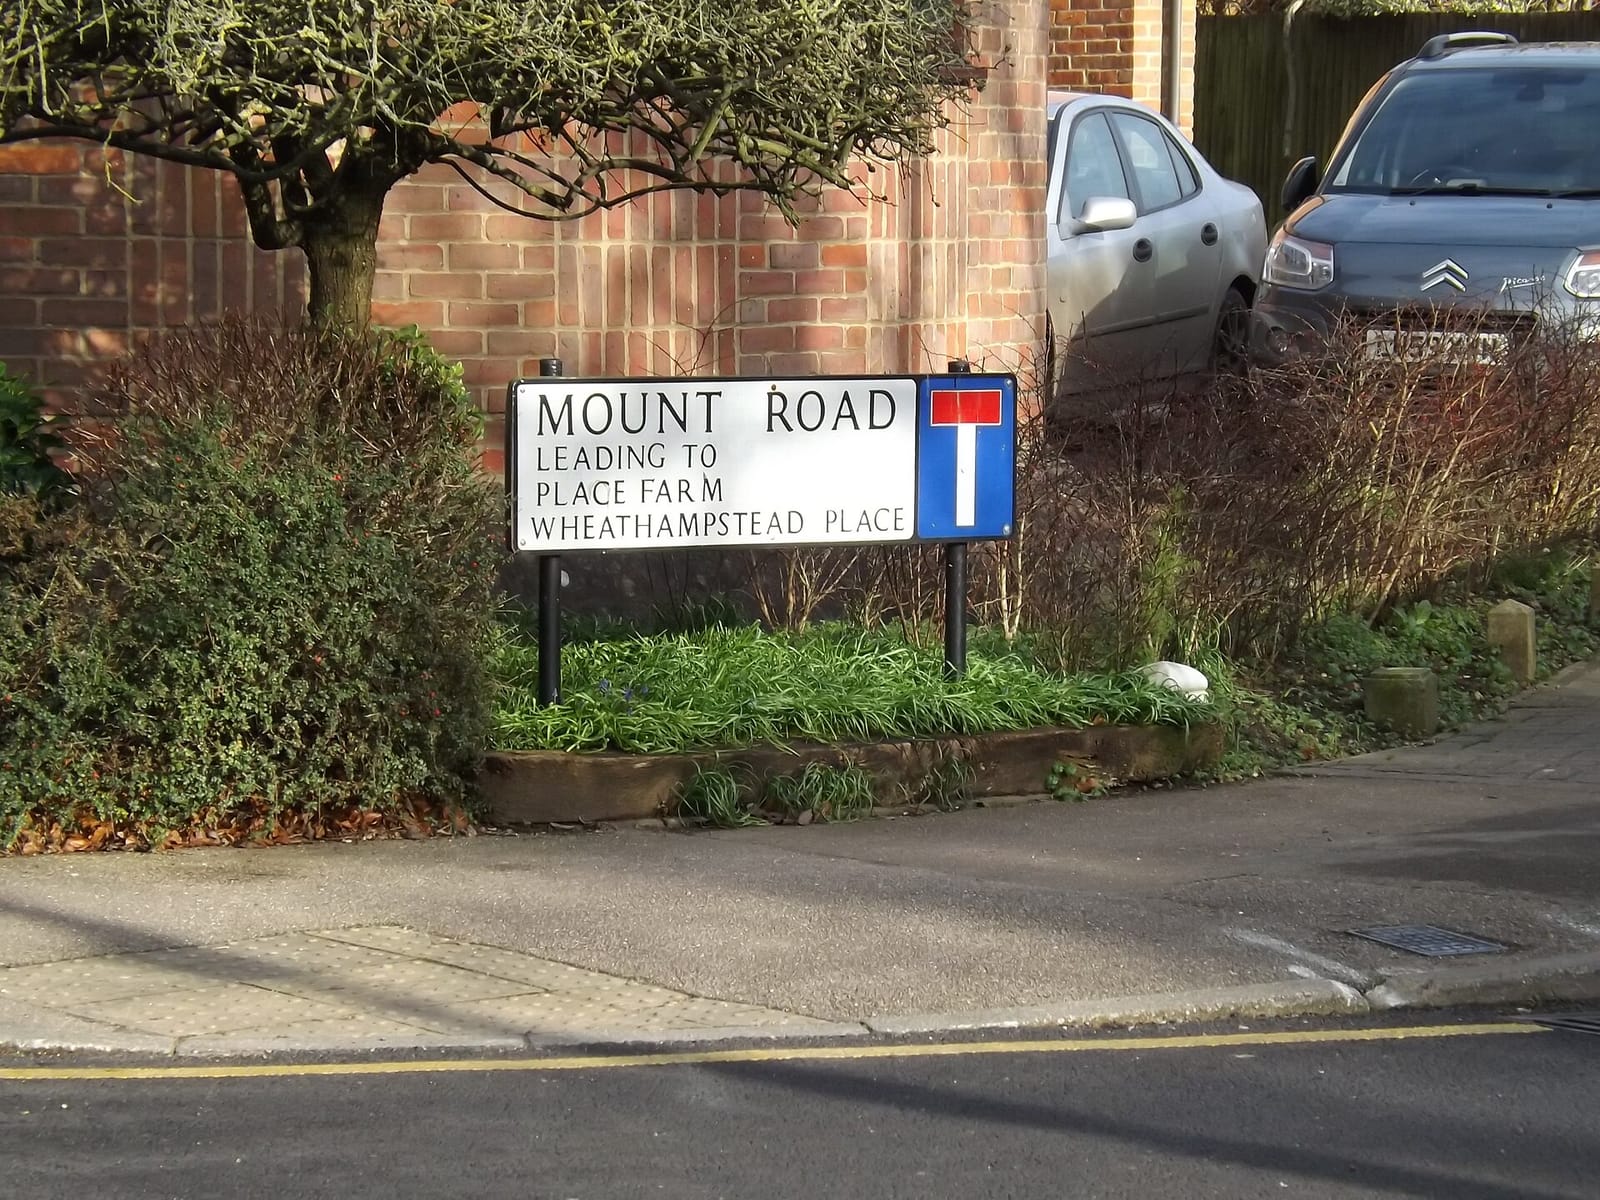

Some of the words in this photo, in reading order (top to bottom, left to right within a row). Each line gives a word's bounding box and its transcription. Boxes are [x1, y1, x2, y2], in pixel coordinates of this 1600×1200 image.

[538, 391, 722, 436] MOUNT
[767, 390, 896, 433] ROAD
[537, 444, 665, 472] LEADING
[682, 443, 718, 469] TO
[537, 480, 627, 507] PLACE
[640, 478, 723, 504] FARM
[530, 511, 805, 540] WHEATHAMPSTEAD
[825, 507, 905, 533] PLACE
